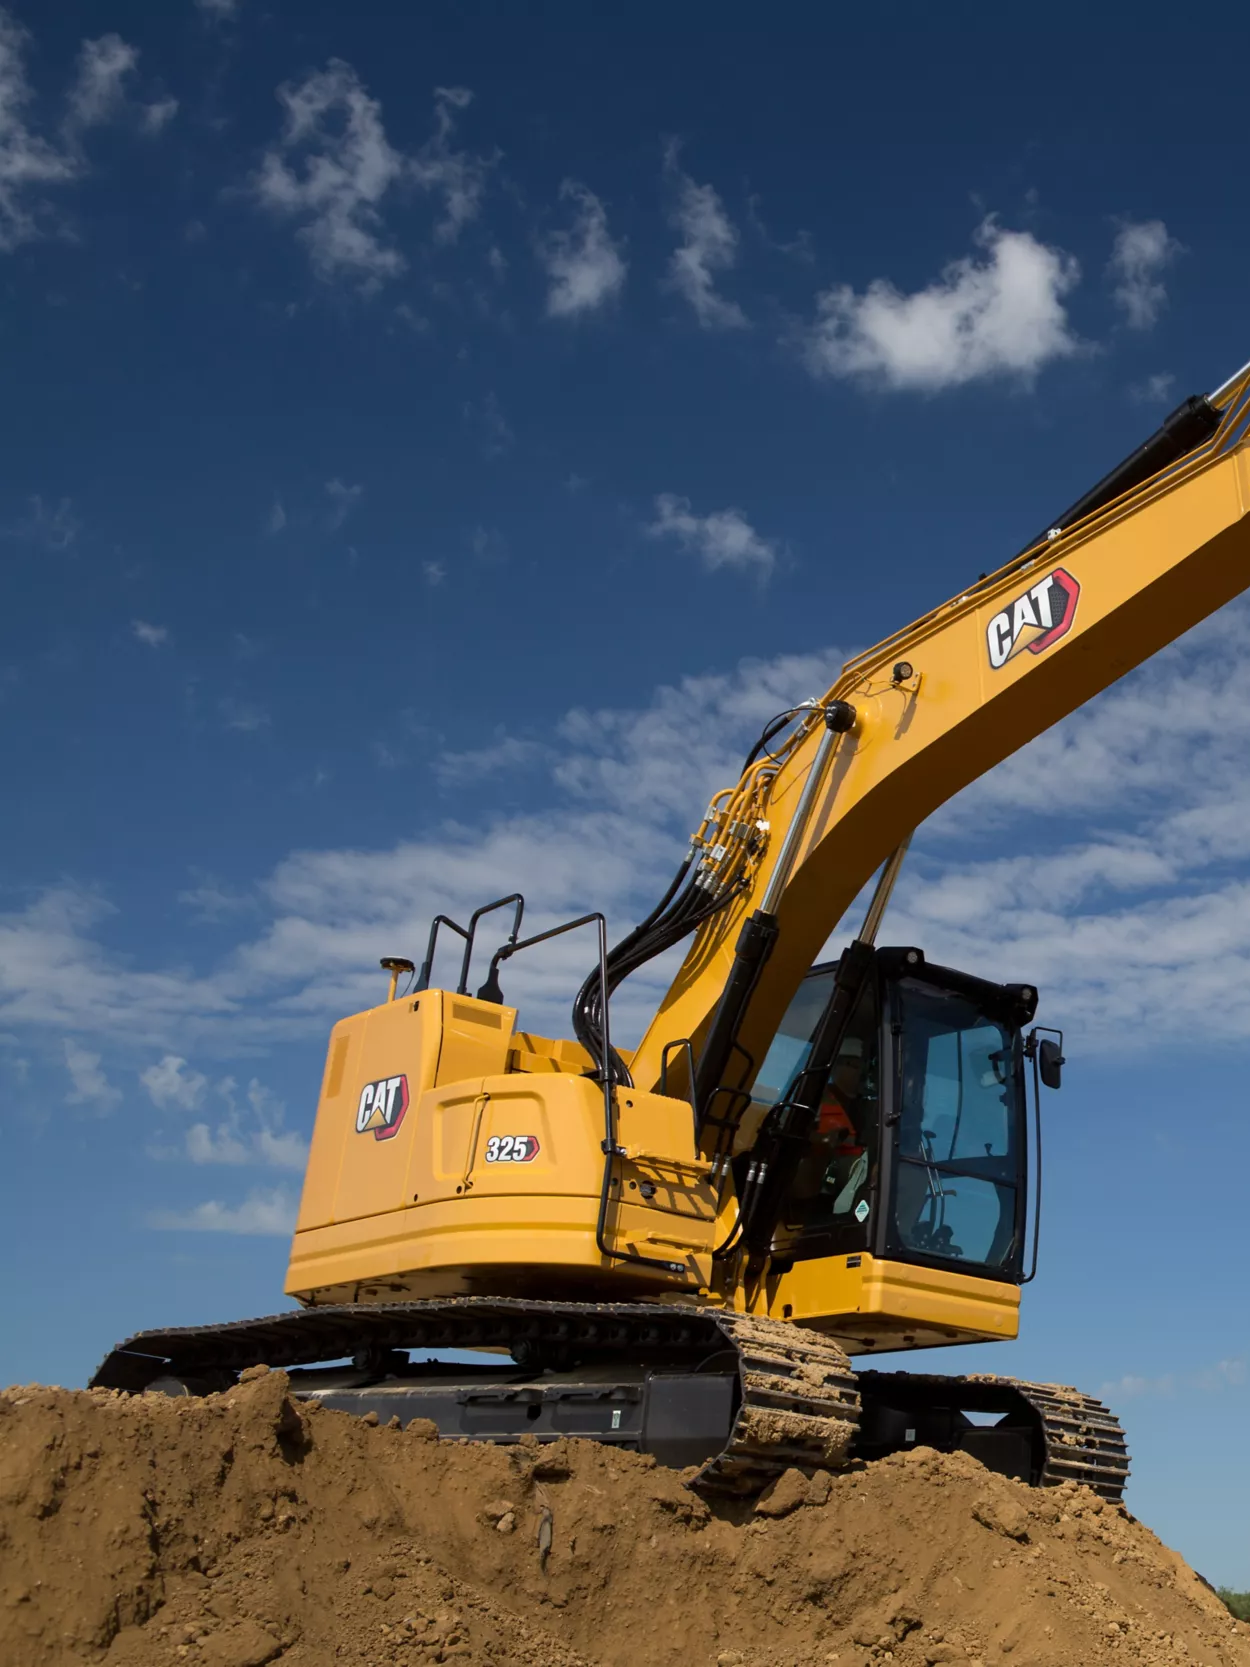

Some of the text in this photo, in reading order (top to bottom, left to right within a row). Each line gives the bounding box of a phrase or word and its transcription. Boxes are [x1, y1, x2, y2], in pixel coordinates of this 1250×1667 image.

[986, 574, 1054, 668] CAT
[356, 1076, 401, 1132] CAT
[485, 1136, 528, 1162] 325
